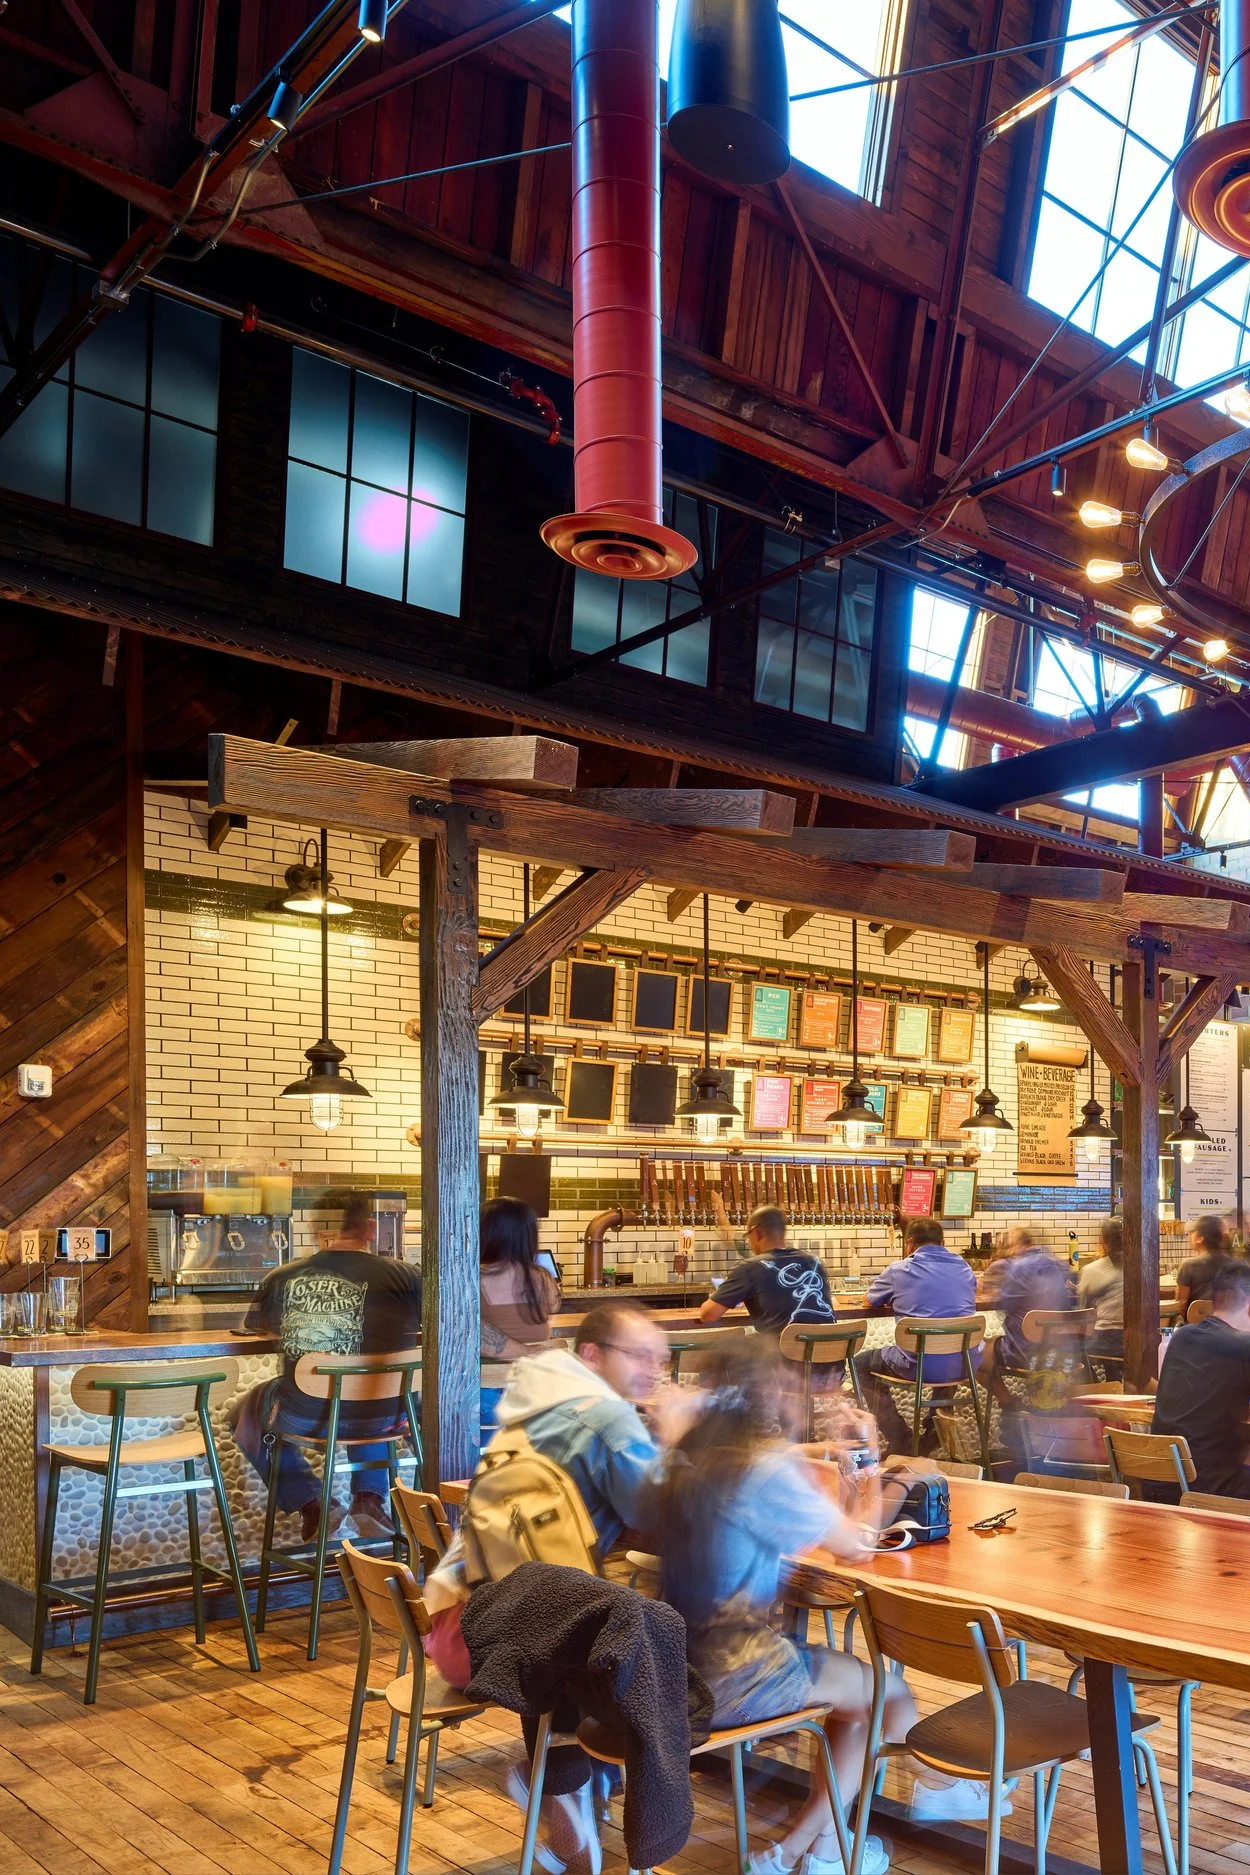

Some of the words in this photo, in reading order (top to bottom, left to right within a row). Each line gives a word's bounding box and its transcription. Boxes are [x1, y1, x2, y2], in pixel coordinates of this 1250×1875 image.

[1020, 1065, 1040, 1080] WINE
[1043, 1067, 1076, 1083] BEVERAGE
[24, 1239, 35, 1255] 22
[41, 1239, 49, 1255] 2
[73, 1237, 90, 1250] 35
[682, 1236, 692, 1249] 10
[287, 1275, 344, 1305] LOSER
[301, 1295, 362, 1313] MACHINE
